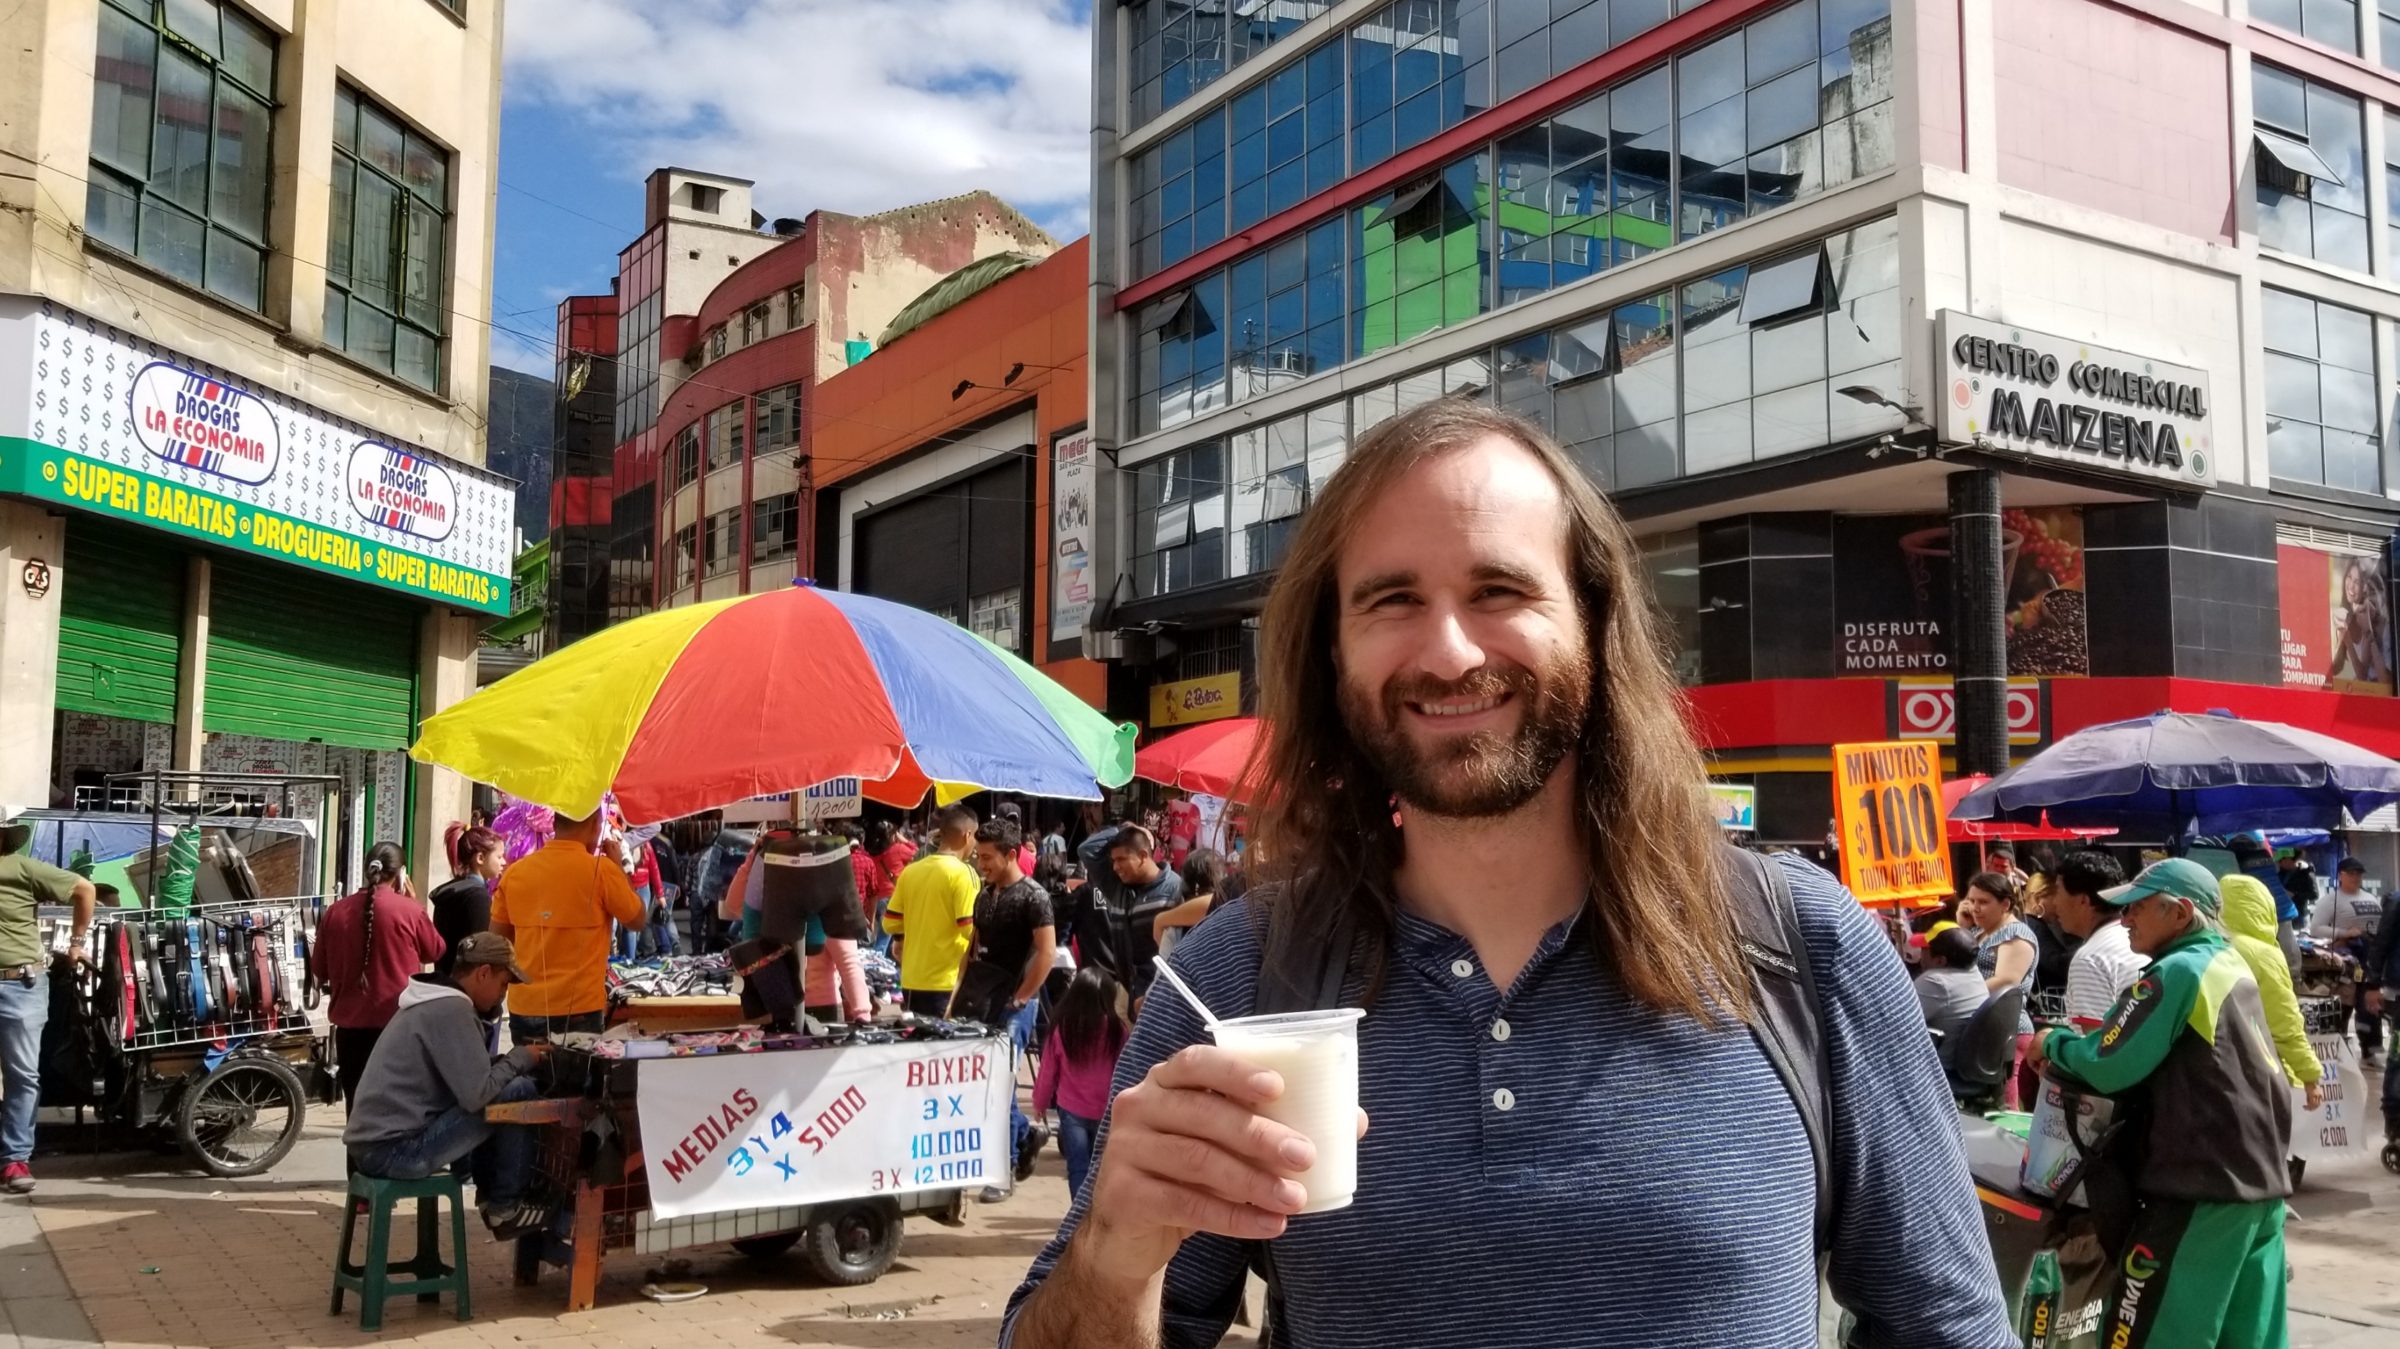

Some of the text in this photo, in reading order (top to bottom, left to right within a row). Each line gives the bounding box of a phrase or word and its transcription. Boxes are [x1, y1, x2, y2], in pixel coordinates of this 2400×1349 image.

[1953, 333, 2207, 418] CENTRO COMERCIAL
[176, 391, 240, 433] DROGAS
[1989, 387, 2183, 468] MAIZENA
[146, 406, 264, 463] LA ECONOMIA
[380, 464, 427, 498] DROGAS
[358, 478, 446, 523] LA ECONOMIA
[63, 457, 489, 604] SUPER BARATAS DROGUERIA SUPER BARATAS
[25, 567, 48, 589] G4S
[1845, 622, 1940, 637] DISFRUTA
[1846, 639, 1899, 653] CADA
[2280, 629, 2291, 642] TU
[1846, 654, 1947, 669] MOMENTO
[1845, 745, 1929, 786] MINUTOS
[1890, 857, 1946, 888] OPERADOR
[2118, 998, 2139, 1028] VIVE
[906, 1054, 986, 1088] BOXER
[923, 1094, 964, 1121] 3 X
[2325, 1103, 2341, 1120] 3 X
[662, 1087, 759, 1184] MEDIAS
[727, 1110, 794, 1176] 3 Y 4
[773, 1152, 798, 1182] X
[872, 1169, 884, 1192] 3
[891, 1167, 902, 1189] X
[2119, 1277, 2145, 1327] VIVE
